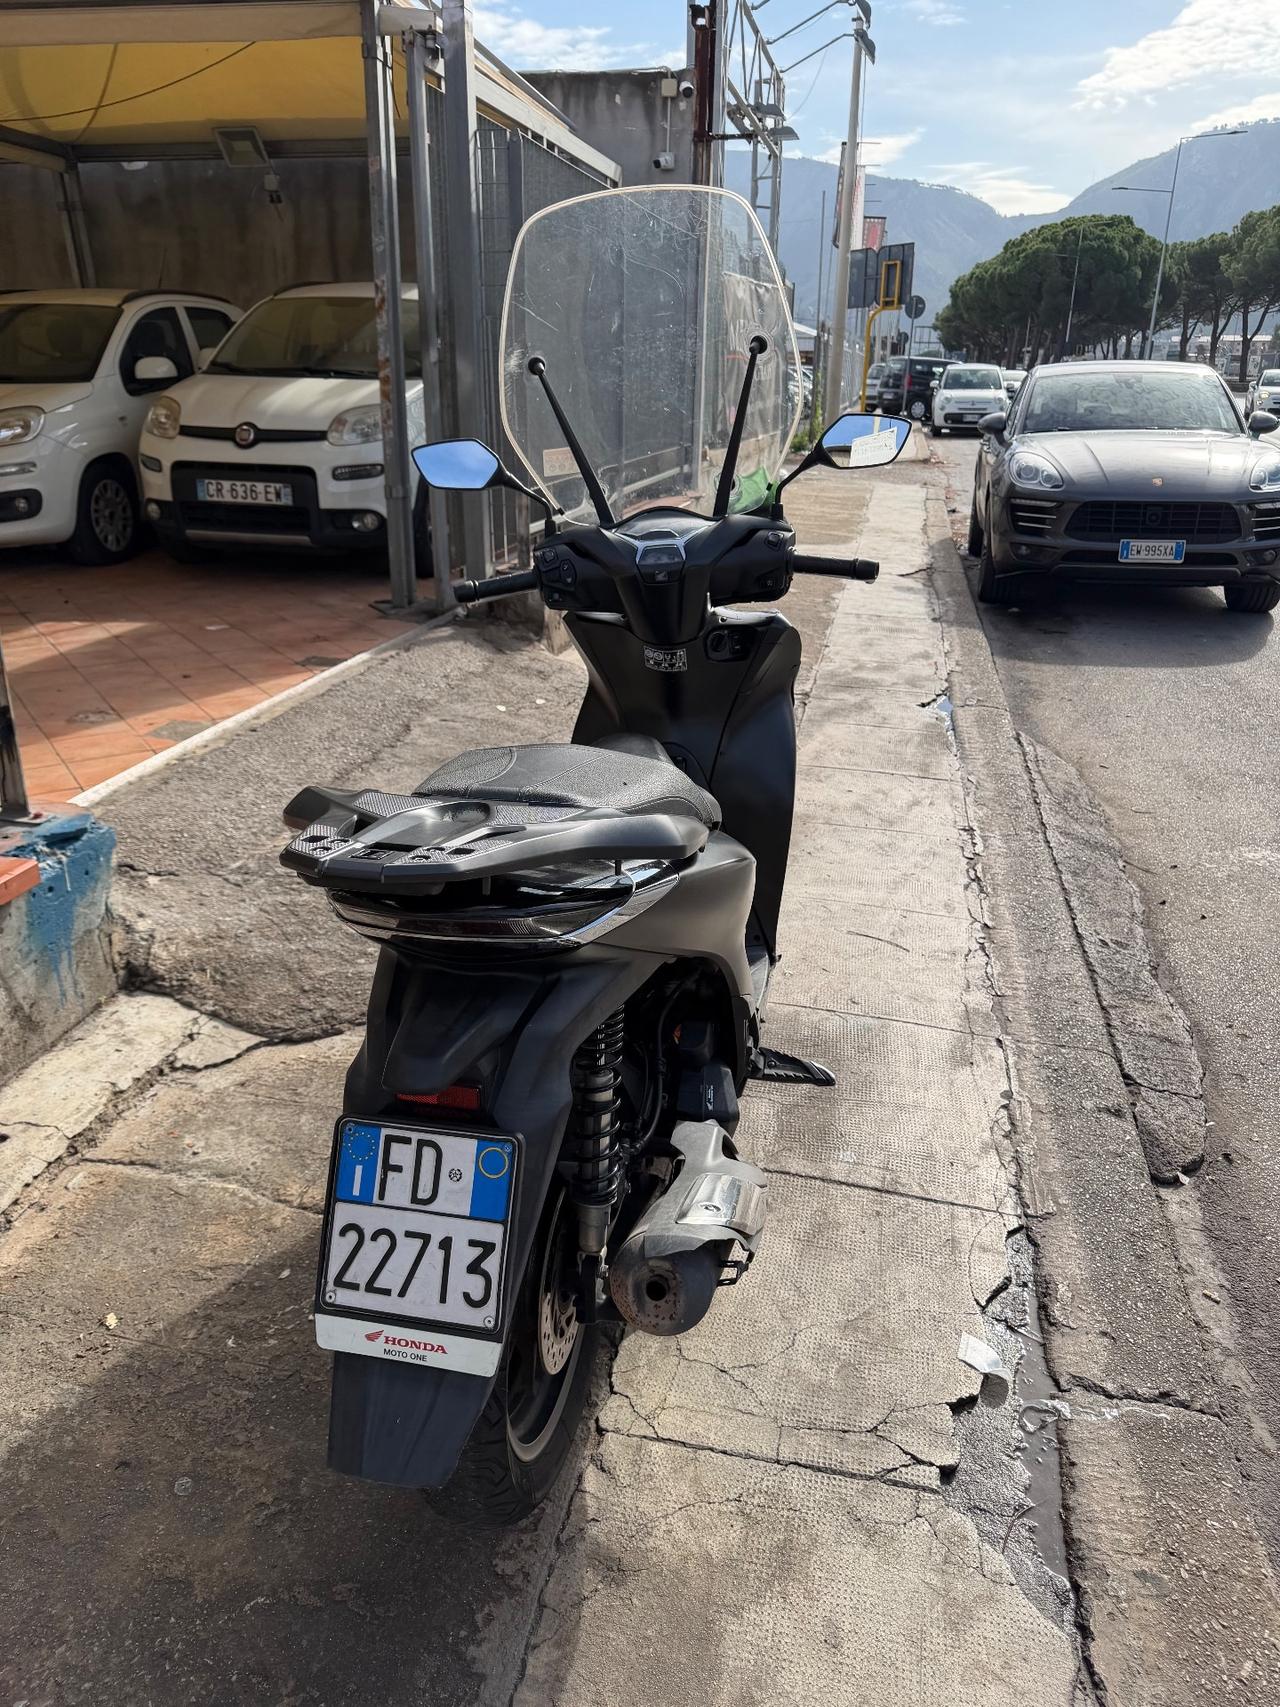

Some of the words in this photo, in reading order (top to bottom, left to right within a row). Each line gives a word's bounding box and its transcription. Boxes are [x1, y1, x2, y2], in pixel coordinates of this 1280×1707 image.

[378, 1134, 443, 1206] FD
[333, 1222, 497, 1309] 22713
[383, 1348, 408, 1359] MOTO
[410, 1352, 428, 1362] ONE
[384, 1335, 449, 1355] HONDA
